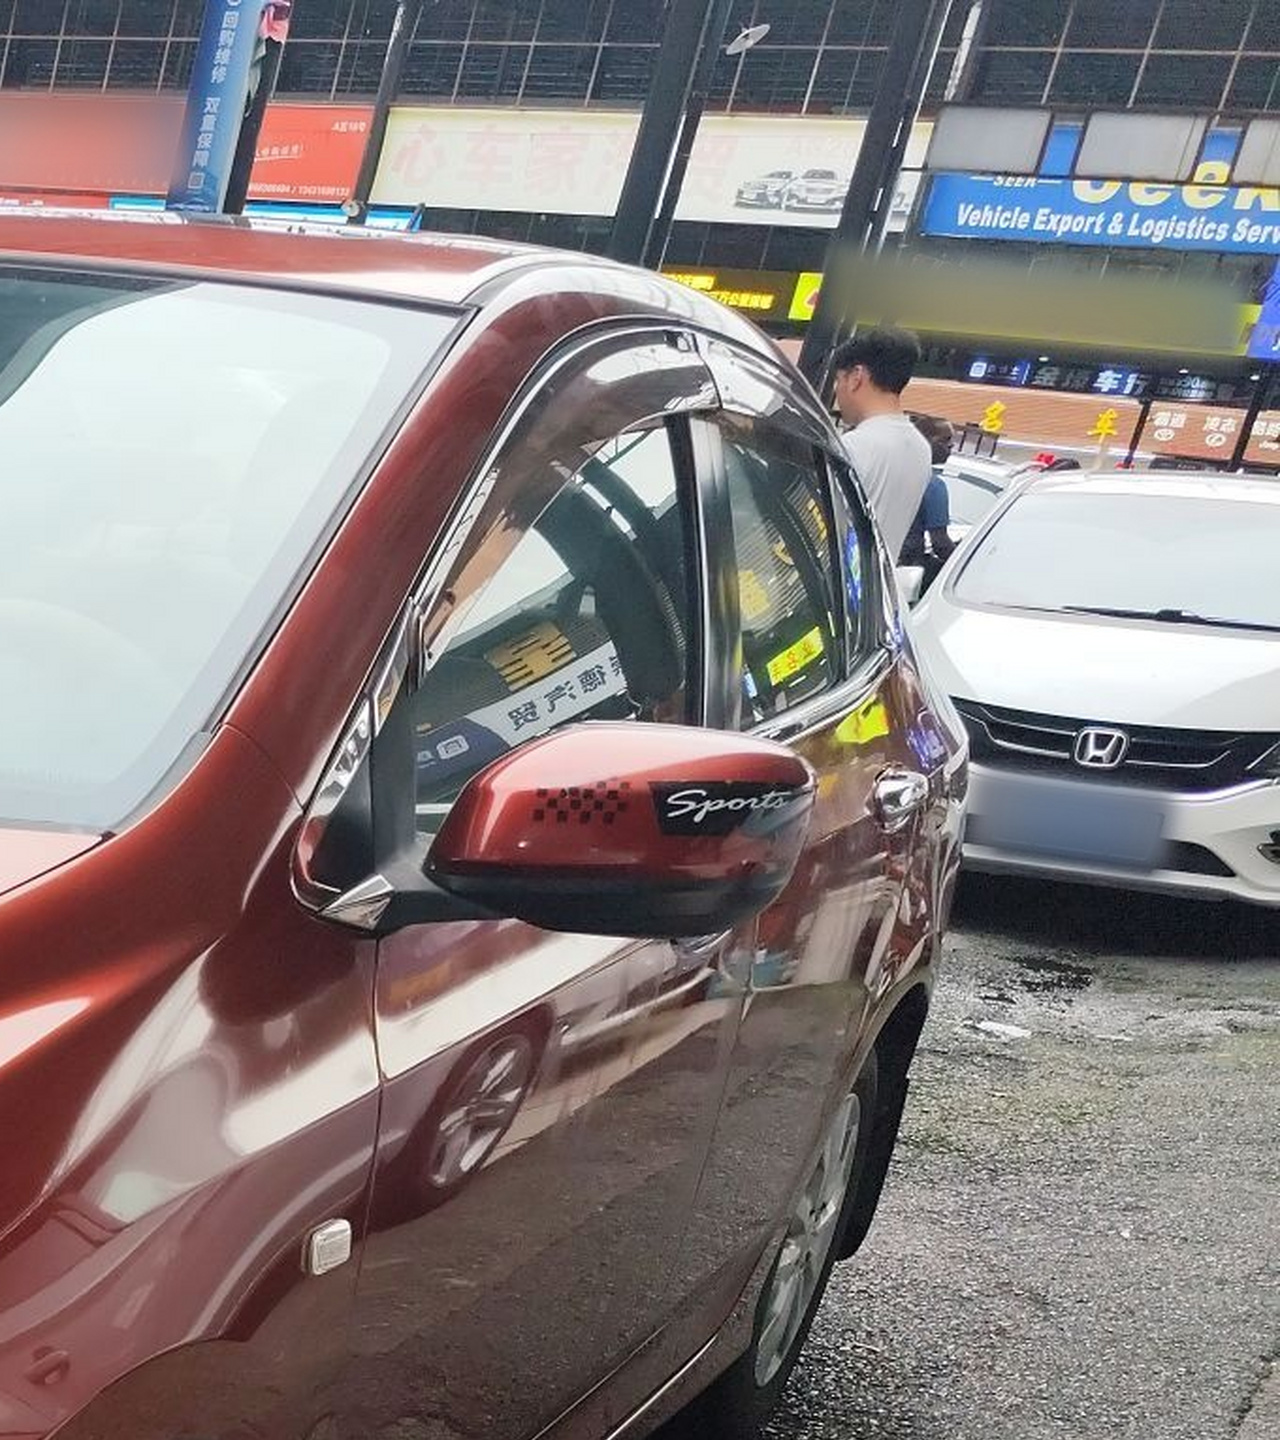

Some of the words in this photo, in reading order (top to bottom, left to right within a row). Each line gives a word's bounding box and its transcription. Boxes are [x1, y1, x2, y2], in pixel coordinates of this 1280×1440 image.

[956, 202, 1031, 230] Vehicle
[1033, 207, 1106, 238] Export
[1107, 211, 1124, 235] &
[1127, 212, 1230, 244] Logistics
[666, 789, 793, 823] Sports
